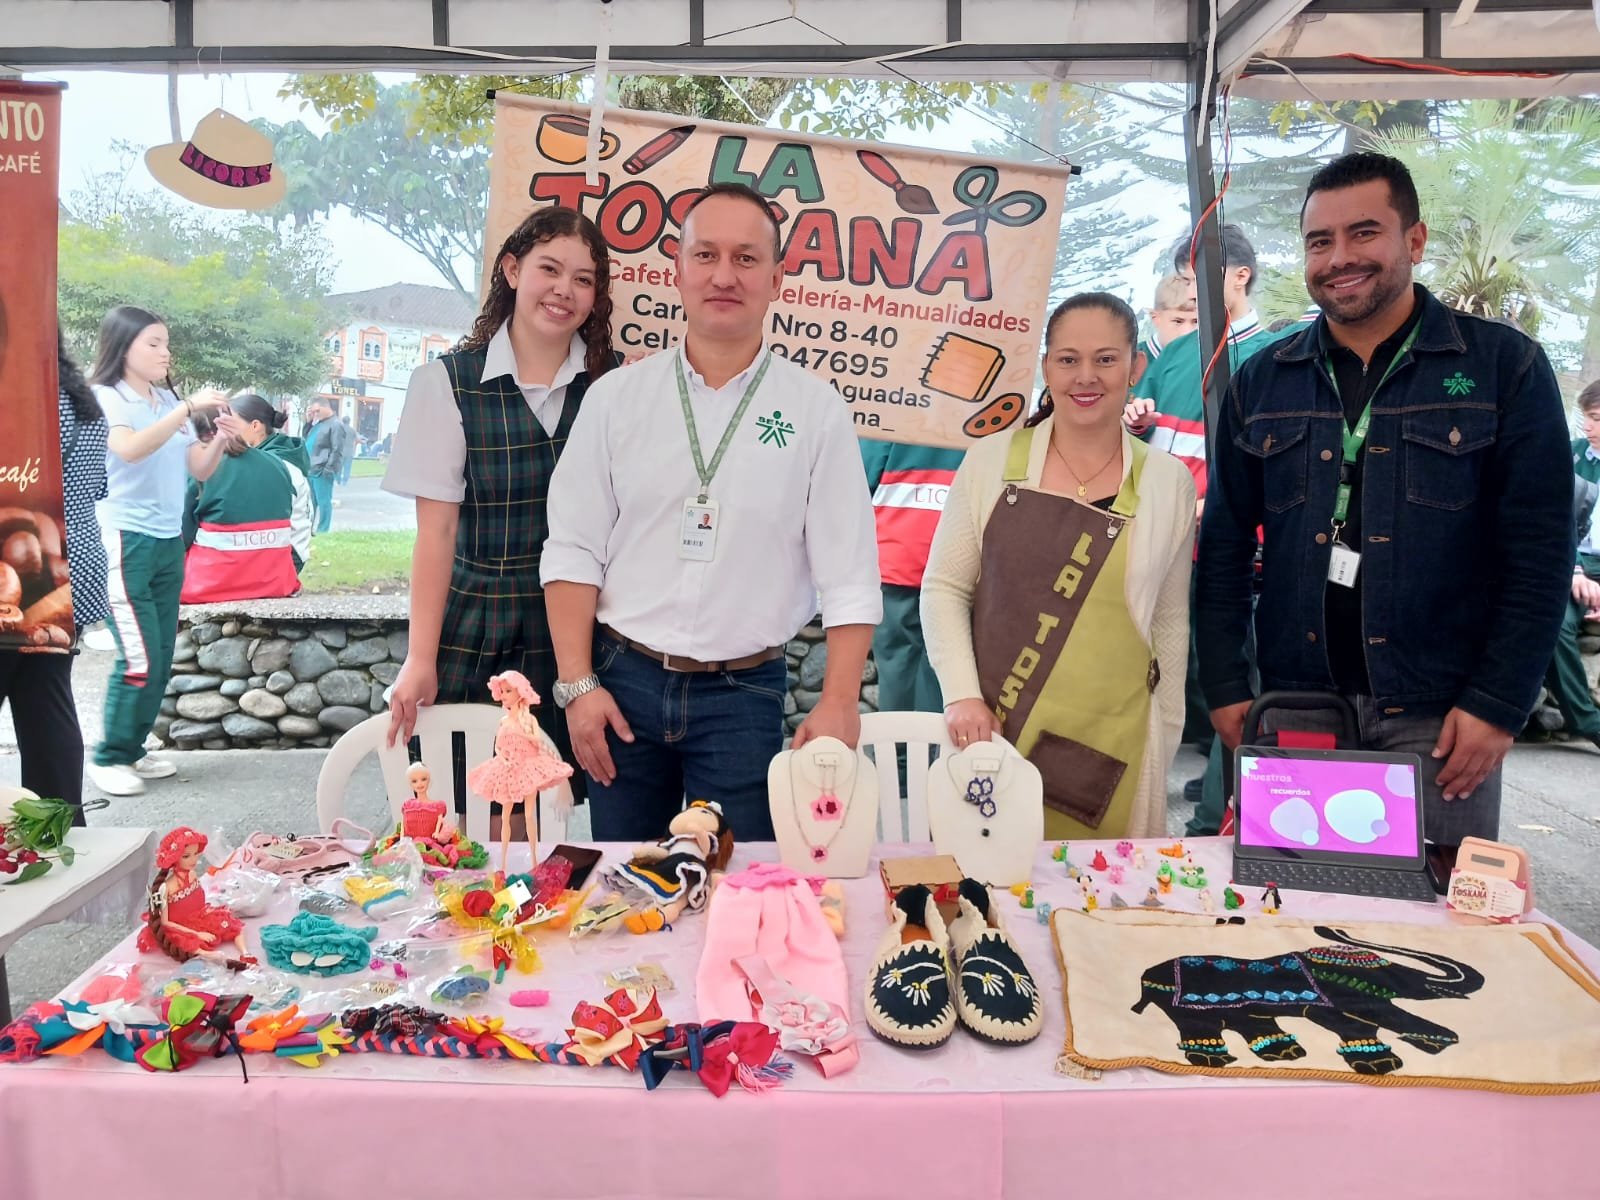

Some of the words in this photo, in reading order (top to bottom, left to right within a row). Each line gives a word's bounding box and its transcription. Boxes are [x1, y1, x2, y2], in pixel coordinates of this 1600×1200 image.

[182, 144, 271, 186] LICORES
[707, 135, 825, 203] LA
[529, 172, 993, 302] TOSANA
[782, 284, 1031, 333] elería-Manualidades
[771, 312, 823, 340] Nro
[829, 320, 899, 349] 8-40
[769, 343, 889, 379] 947695
[757, 416, 794, 430] SENA
[914, 487, 948, 505] LIC
[232, 531, 277, 547] LICEO
[1053, 532, 1093, 599] LA
